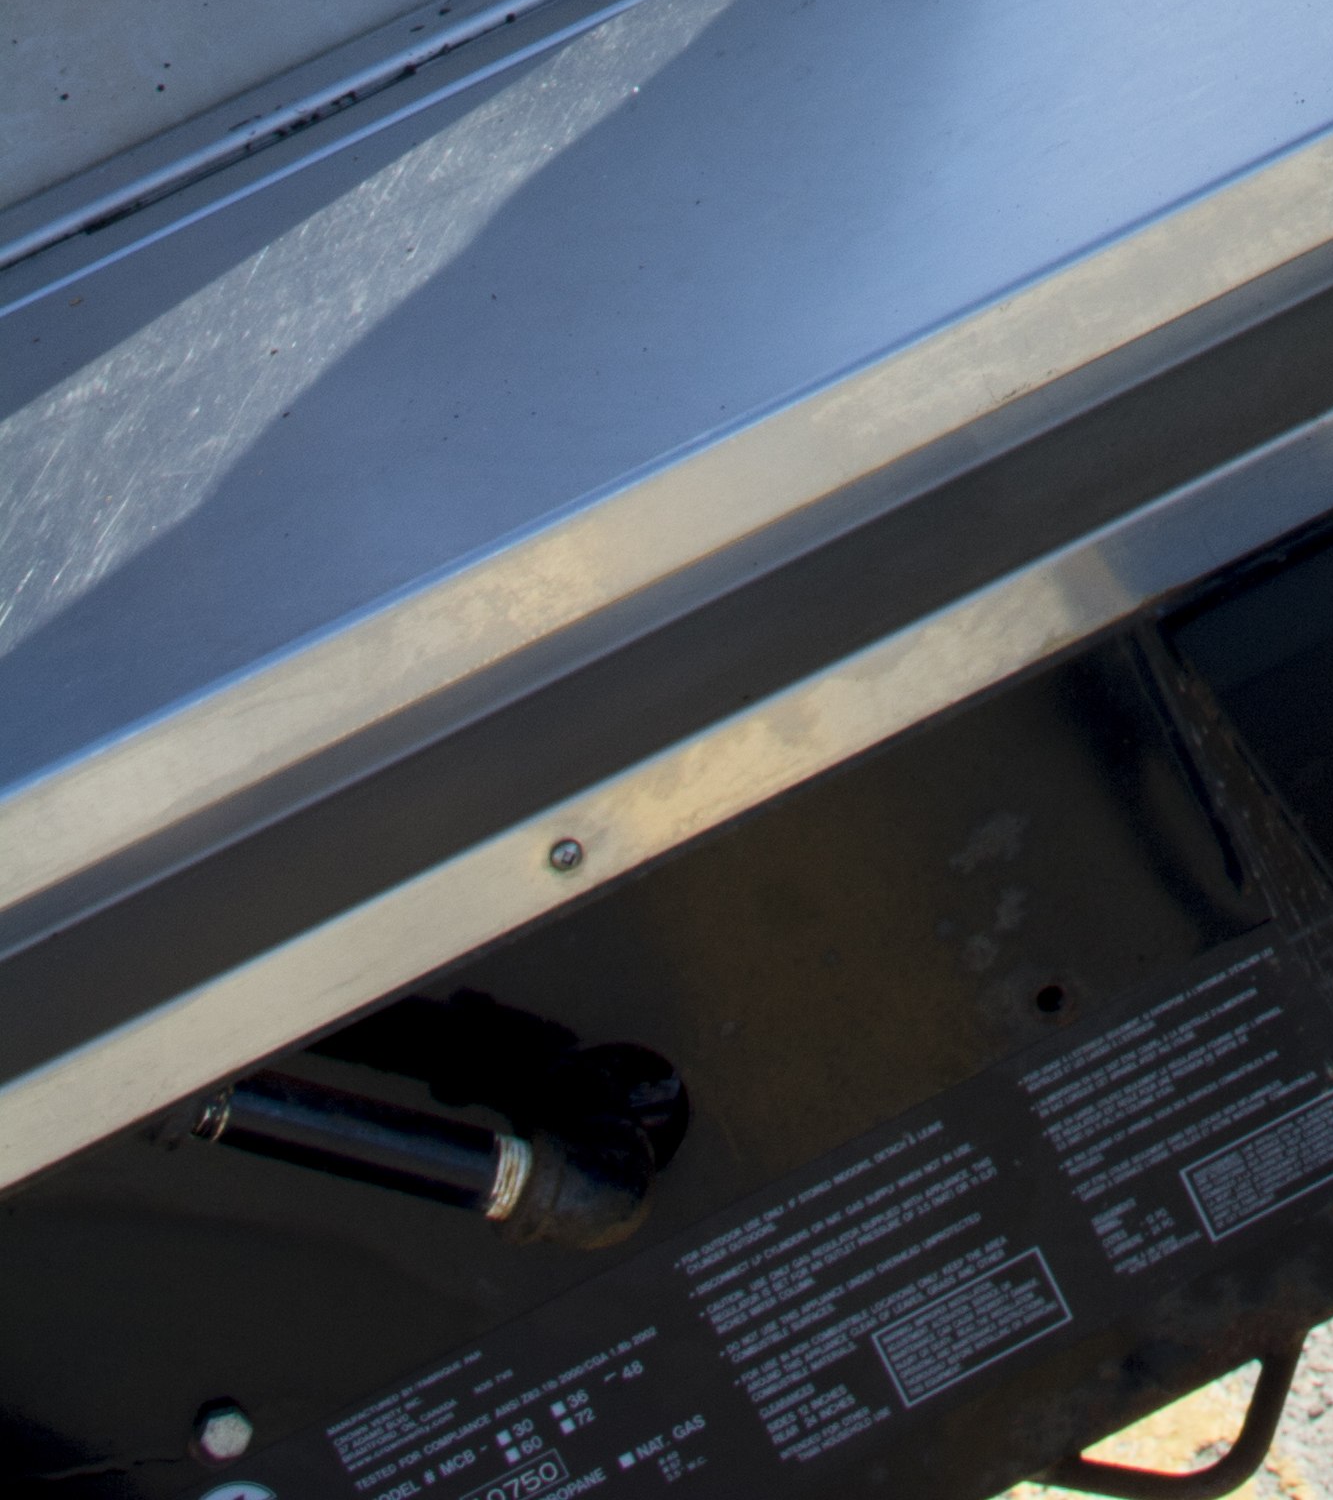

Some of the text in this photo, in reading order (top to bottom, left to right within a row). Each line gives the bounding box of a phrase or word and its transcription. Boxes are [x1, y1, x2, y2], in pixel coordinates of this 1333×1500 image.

[513, 1360, 645, 1438] 30 36 48
[354, 1461, 398, 1492] TESTED
[397, 1448, 423, 1469] FOR
[422, 1412, 492, 1456] COMPLIANCE
[520, 1406, 598, 1454] 60 72
[672, 1414, 707, 1440] GAS
[373, 1480, 421, 1500] ODEL
[438, 1449, 476, 1478] MCB
